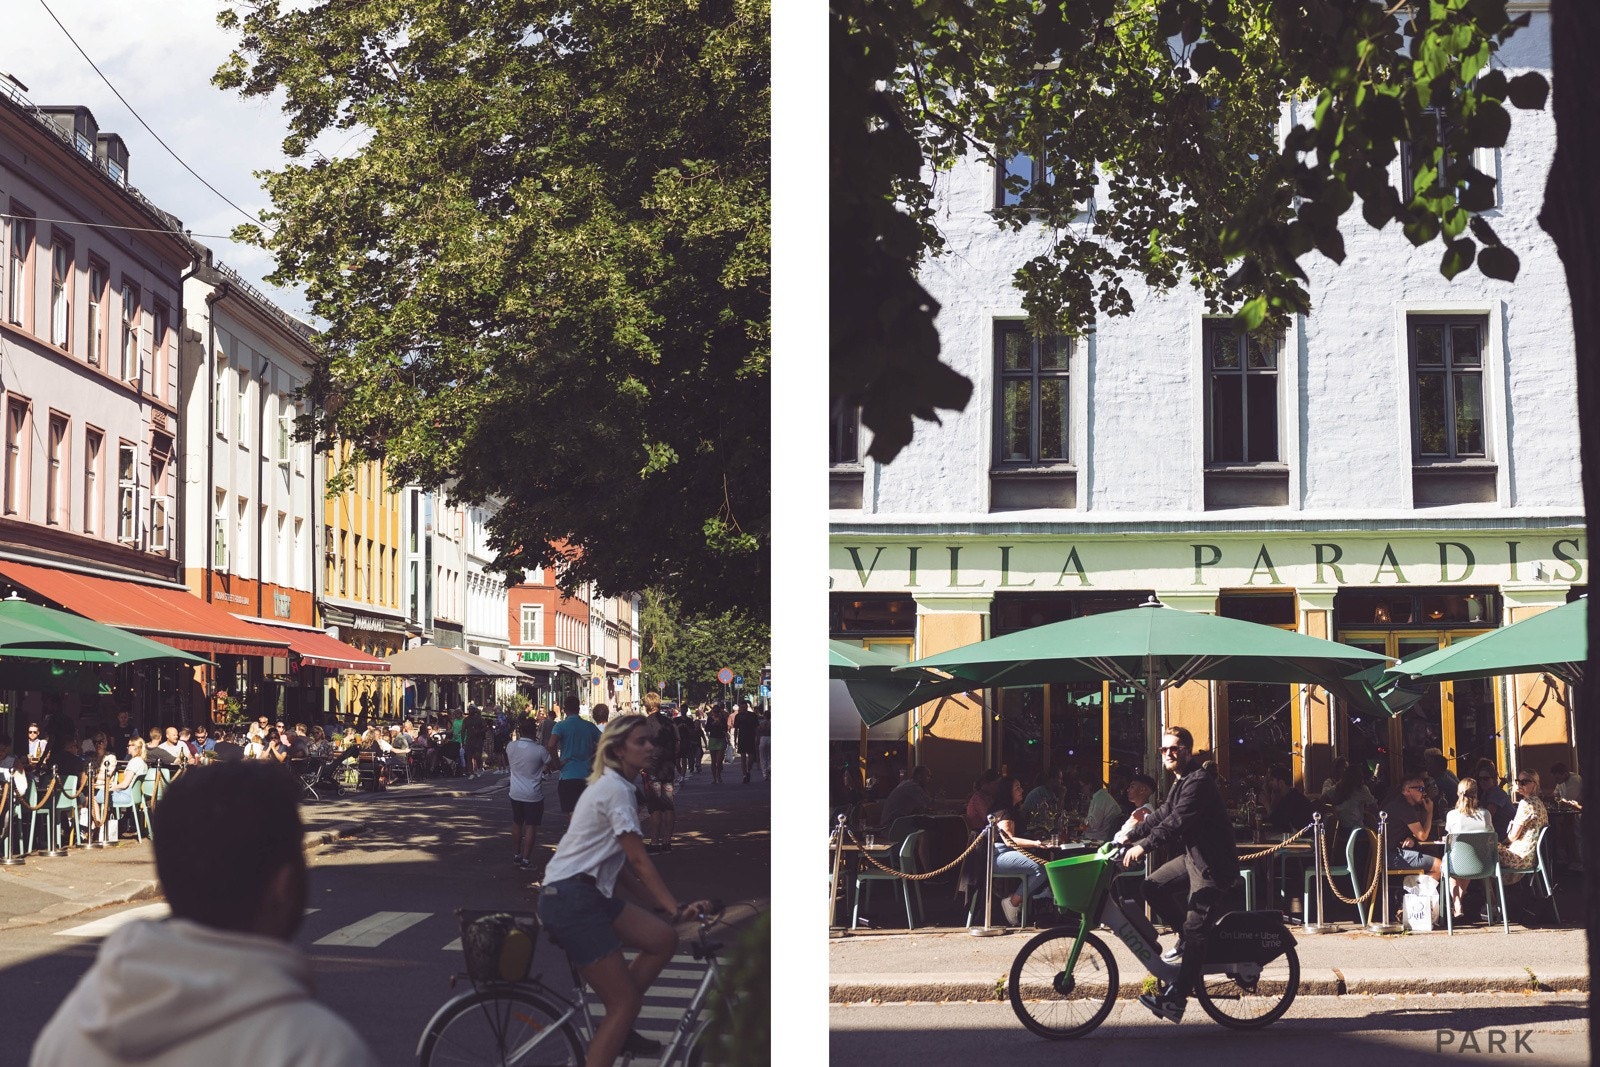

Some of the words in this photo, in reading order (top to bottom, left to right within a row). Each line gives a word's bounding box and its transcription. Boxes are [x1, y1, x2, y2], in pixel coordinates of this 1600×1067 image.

[844, 545, 1094, 588] VILLA
[1190, 539, 1584, 586] PARADIS
[1119, 922, 1152, 961] Lime
[1219, 930, 1232, 939] On
[1234, 930, 1253, 939] Lime
[1260, 931, 1280, 940] Uber
